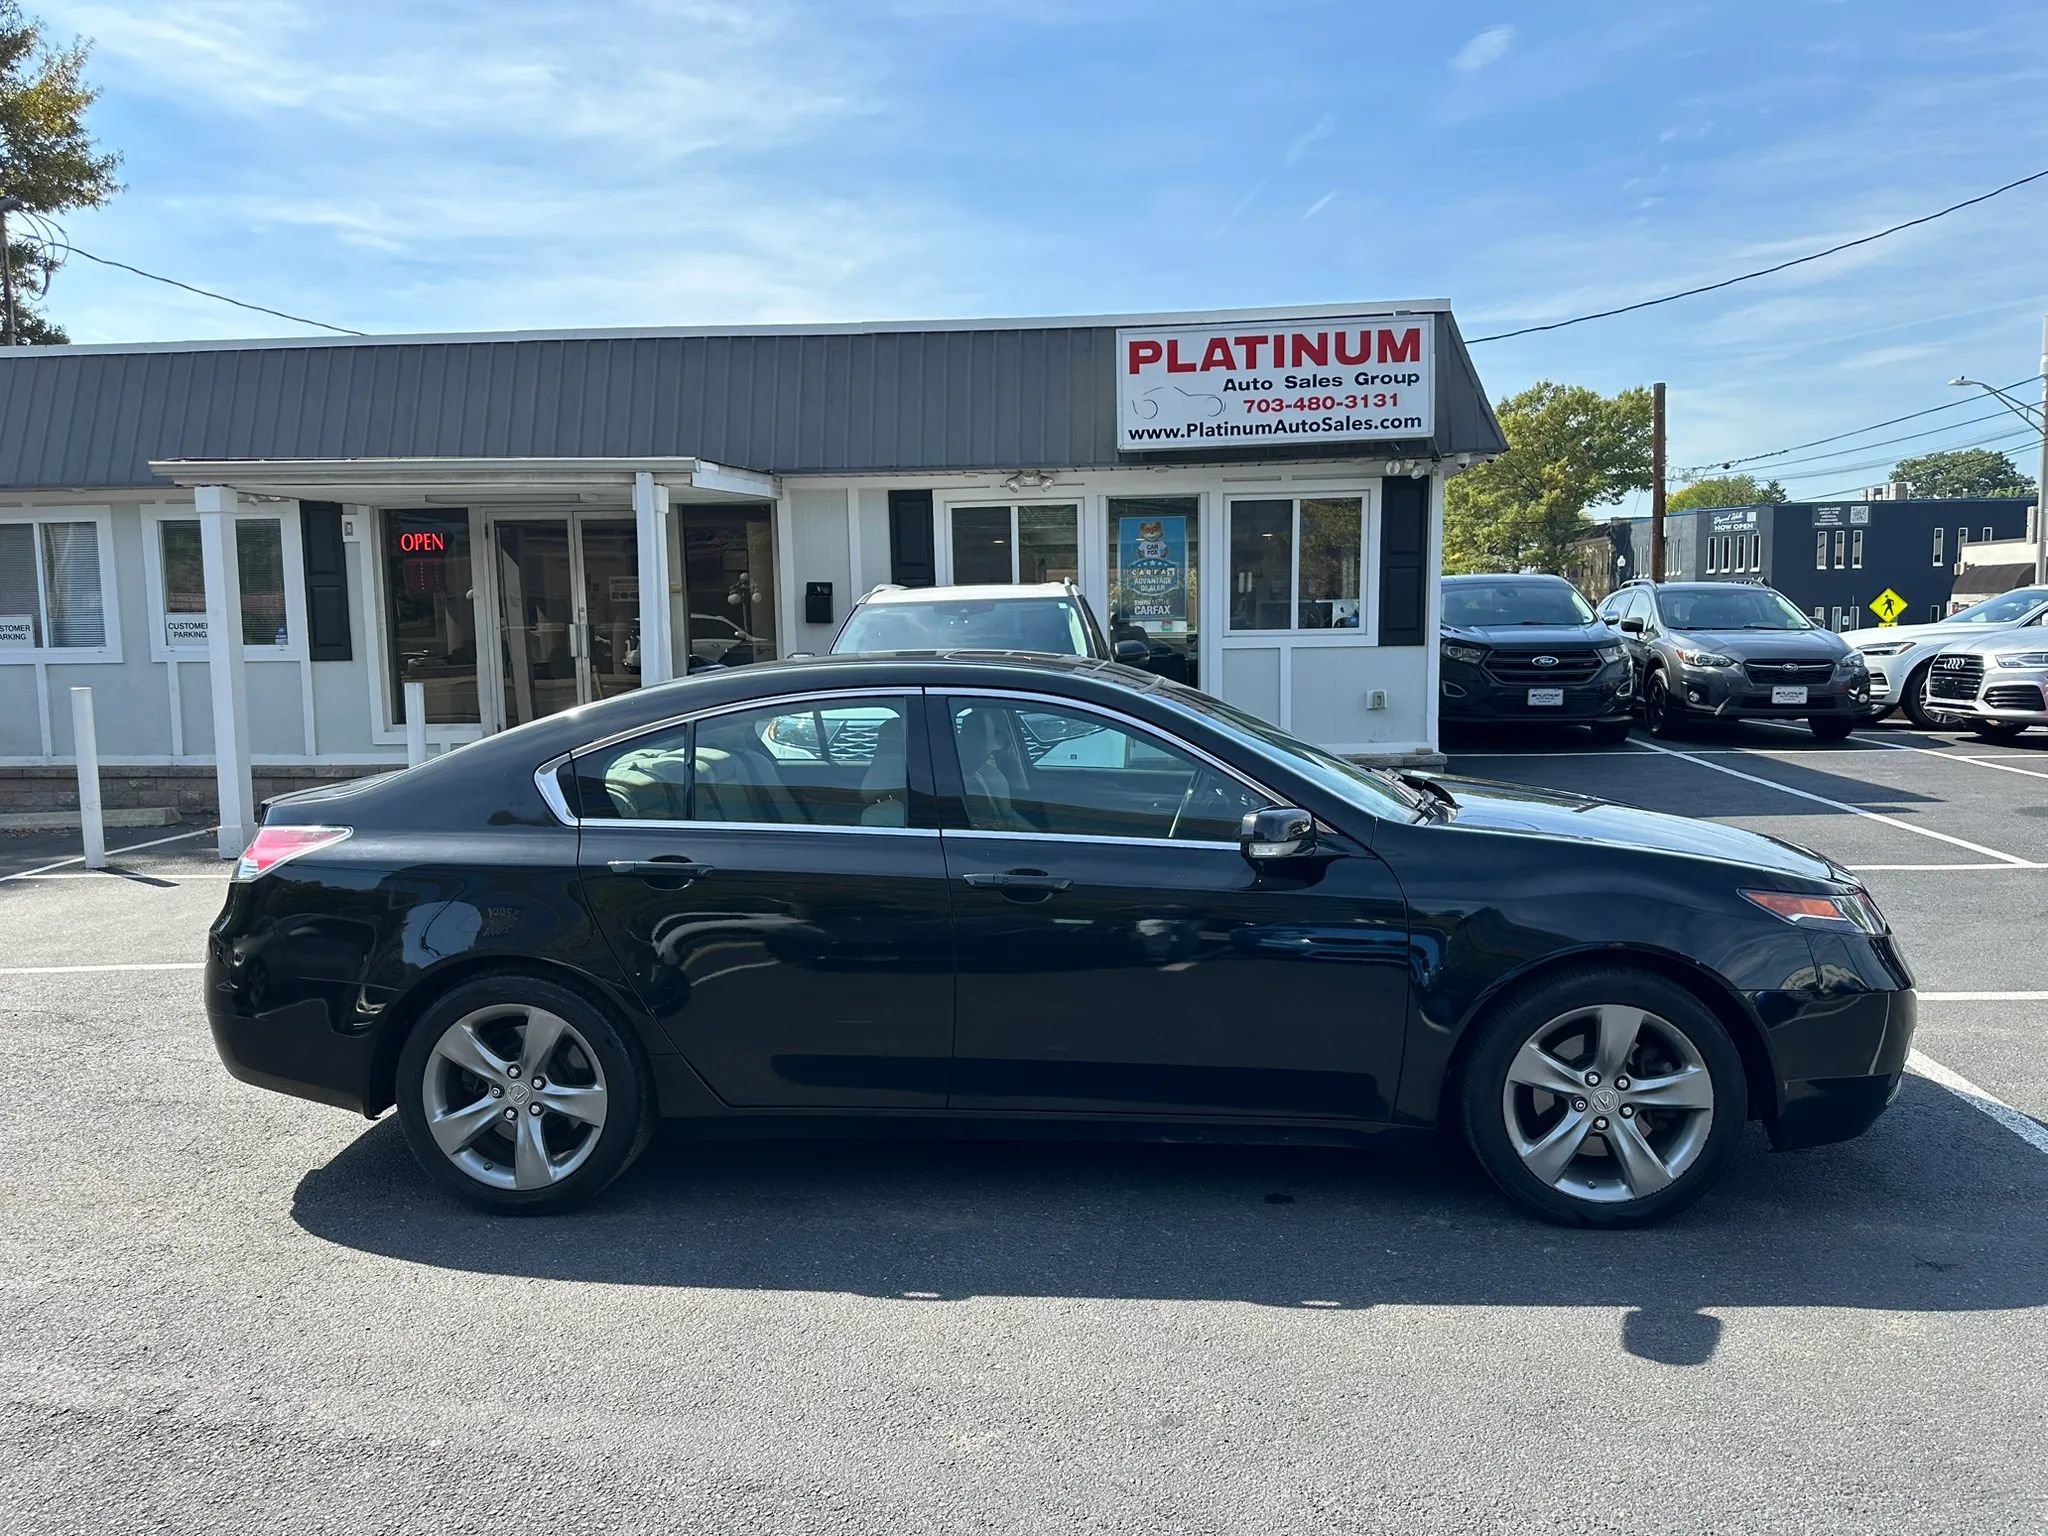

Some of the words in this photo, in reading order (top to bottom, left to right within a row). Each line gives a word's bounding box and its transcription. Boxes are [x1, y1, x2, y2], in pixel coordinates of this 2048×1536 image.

[1129, 328, 1420, 374] PLATINUM
[1223, 378, 1273, 392] Auto
[1284, 374, 1343, 389] Sales
[1354, 372, 1420, 386] Group
[1243, 393, 1398, 414] 703-480-3131
[1128, 415, 1422, 440] www.PlatinumAutoSales.com
[401, 533, 444, 551] OPEN
[1131, 568, 1175, 576] CARFAX
[1134, 605, 1171, 615] CARFAX
[174, 631, 207, 639] PARKING
